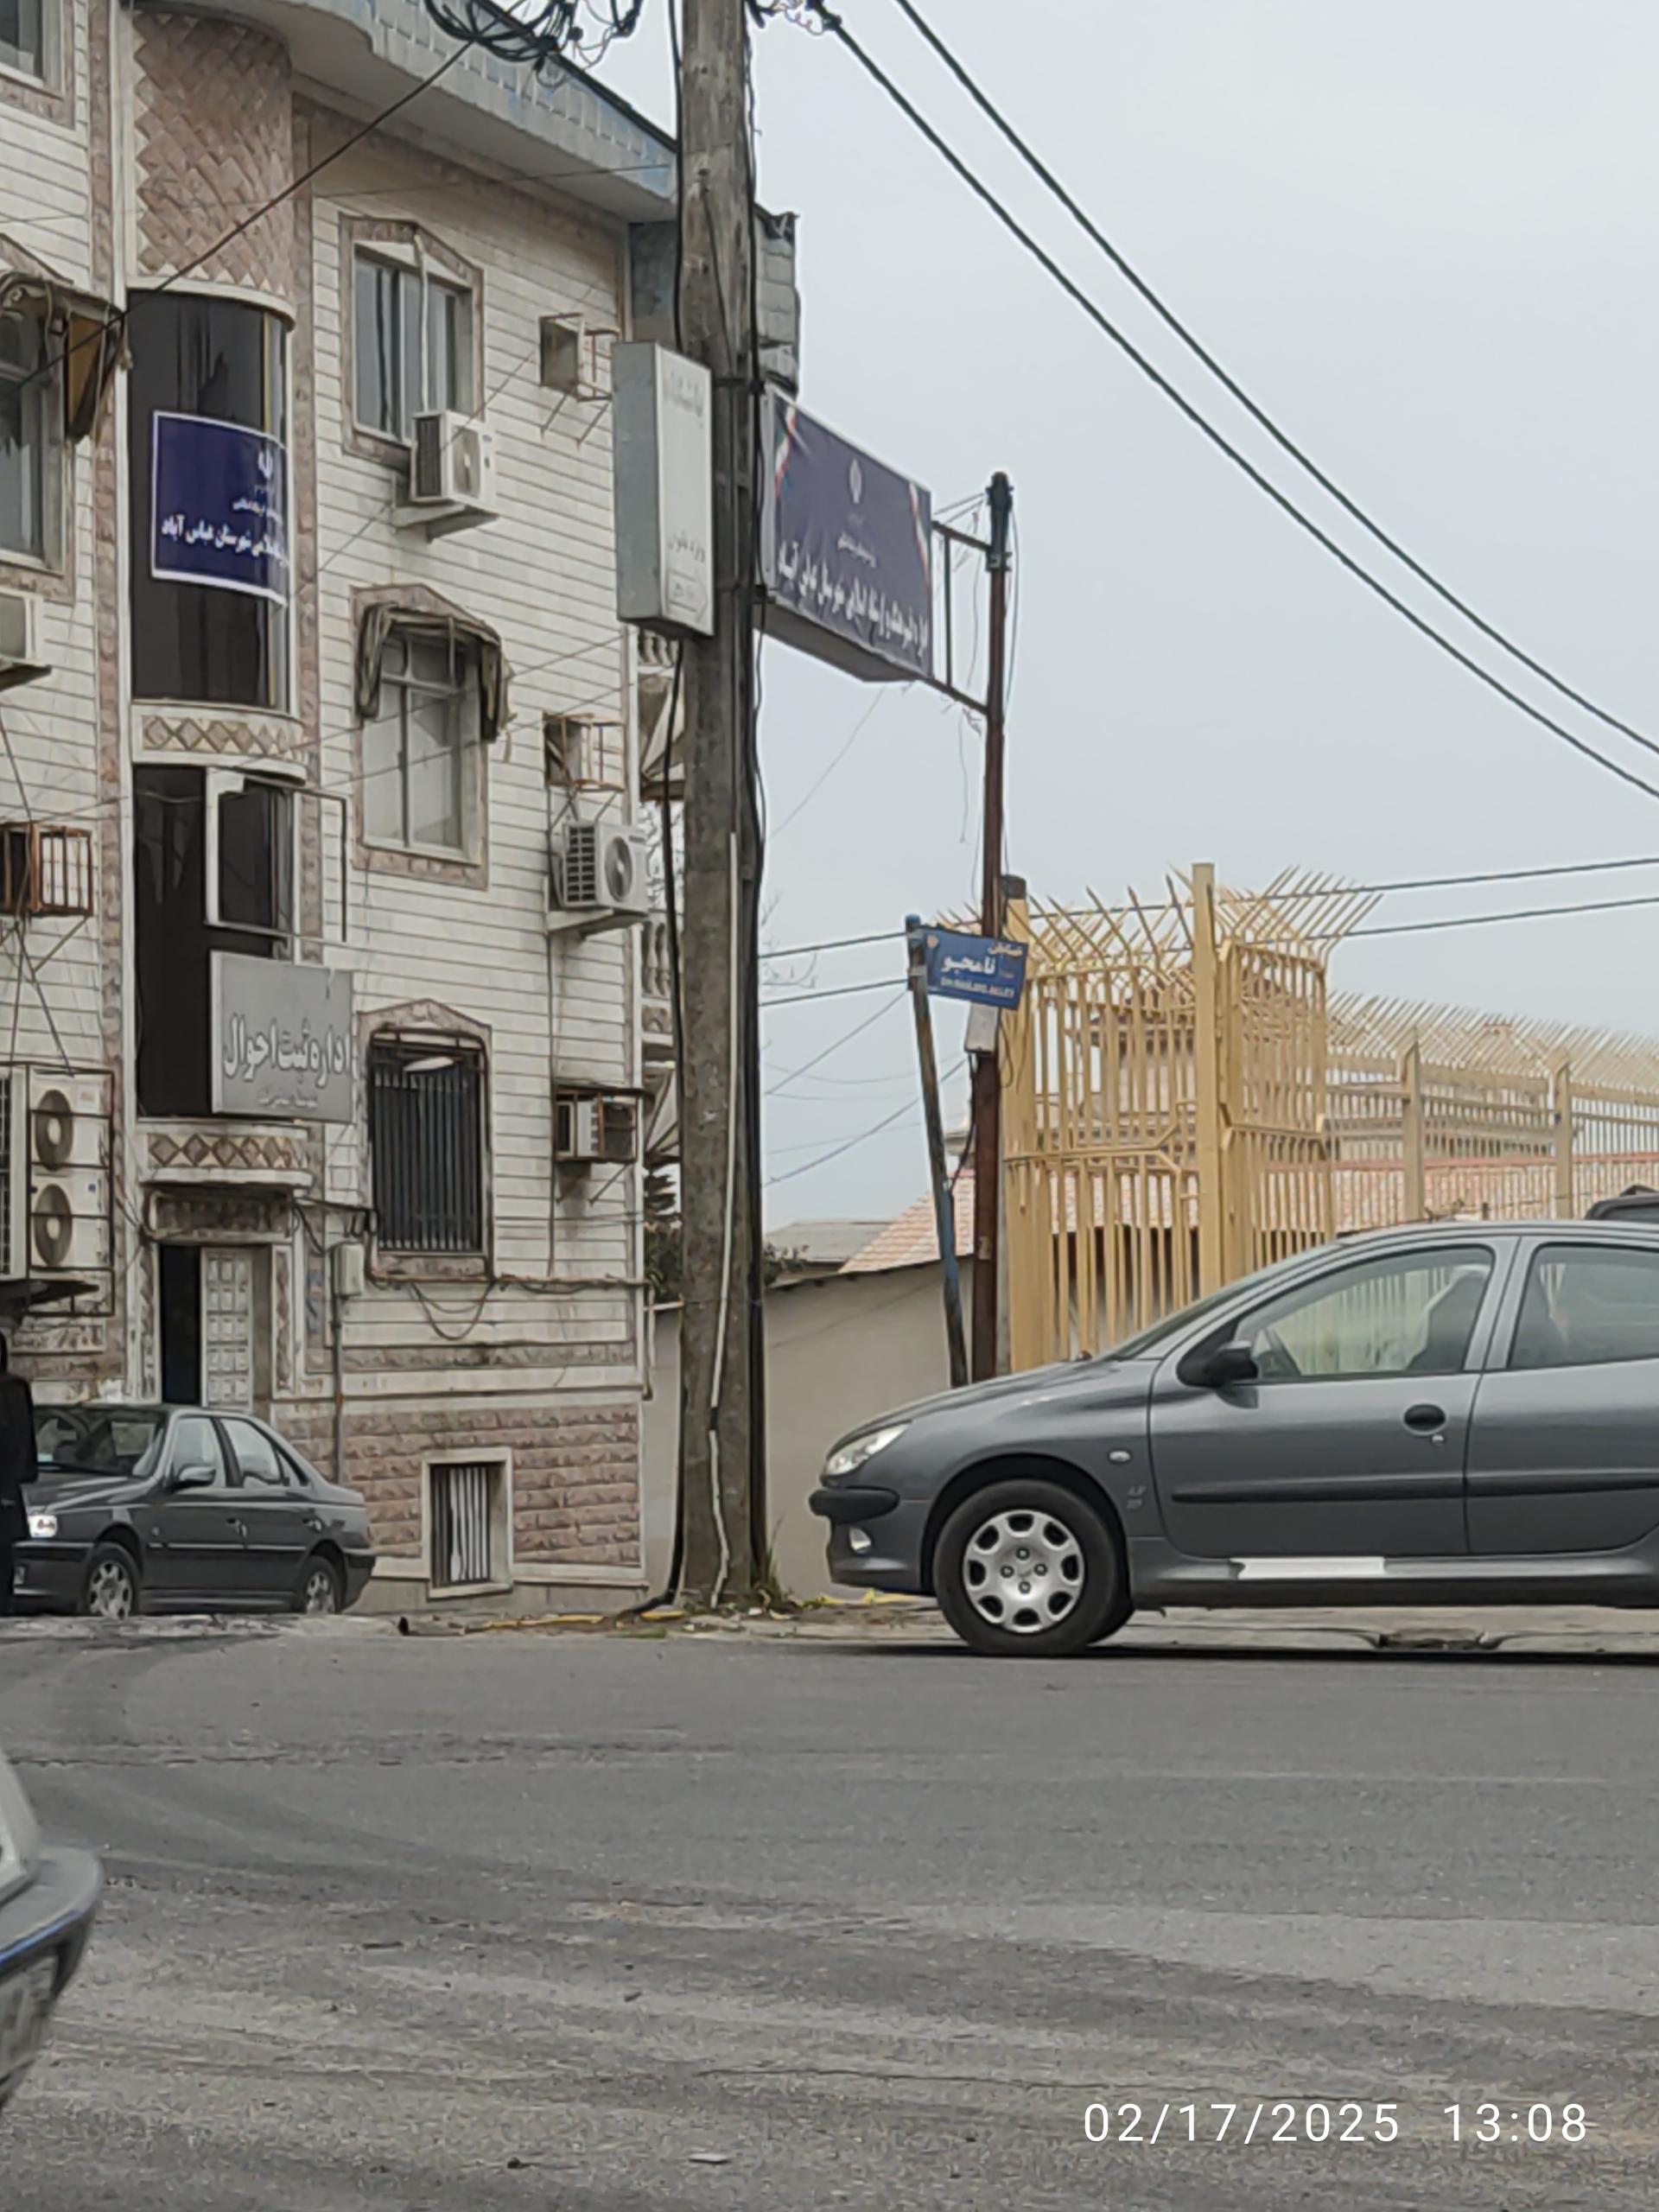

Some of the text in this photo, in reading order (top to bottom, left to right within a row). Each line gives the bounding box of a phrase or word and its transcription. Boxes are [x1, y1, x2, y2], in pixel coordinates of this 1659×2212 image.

[223, 1012, 350, 1089] اداره ثبت احوال
